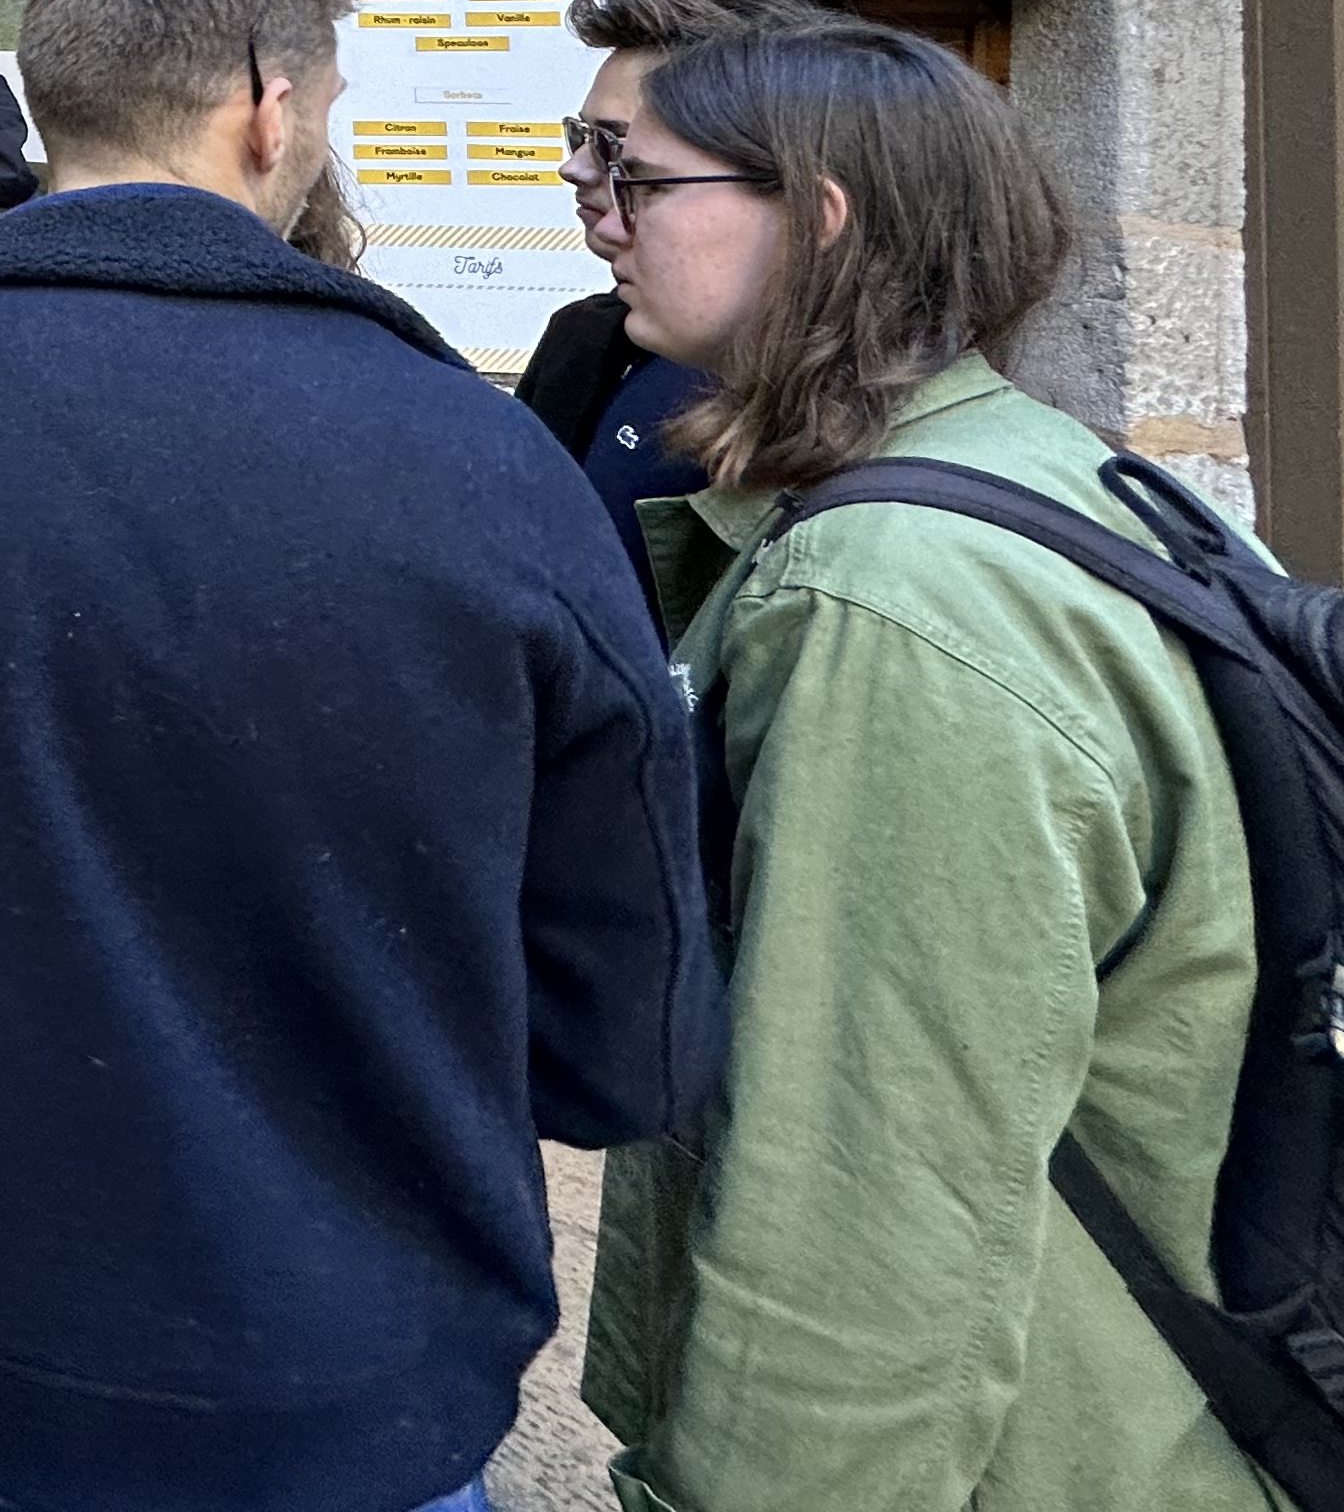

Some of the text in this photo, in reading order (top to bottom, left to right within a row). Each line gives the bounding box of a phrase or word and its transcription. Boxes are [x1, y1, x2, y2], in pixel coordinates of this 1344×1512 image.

[373, 15, 401, 25] Rhum
[409, 15, 436, 25] raisin
[496, 13, 530, 23] Vanille
[443, 91, 483, 100] Sorbets
[384, 123, 416, 132] Citron
[499, 124, 531, 134] Fraise
[375, 146, 427, 156] Framboise
[495, 147, 536, 158] Mangue
[386, 172, 423, 182] Myrtille
[491, 172, 540, 182] Chocolat
[453, 256, 503, 279] Tarifs
